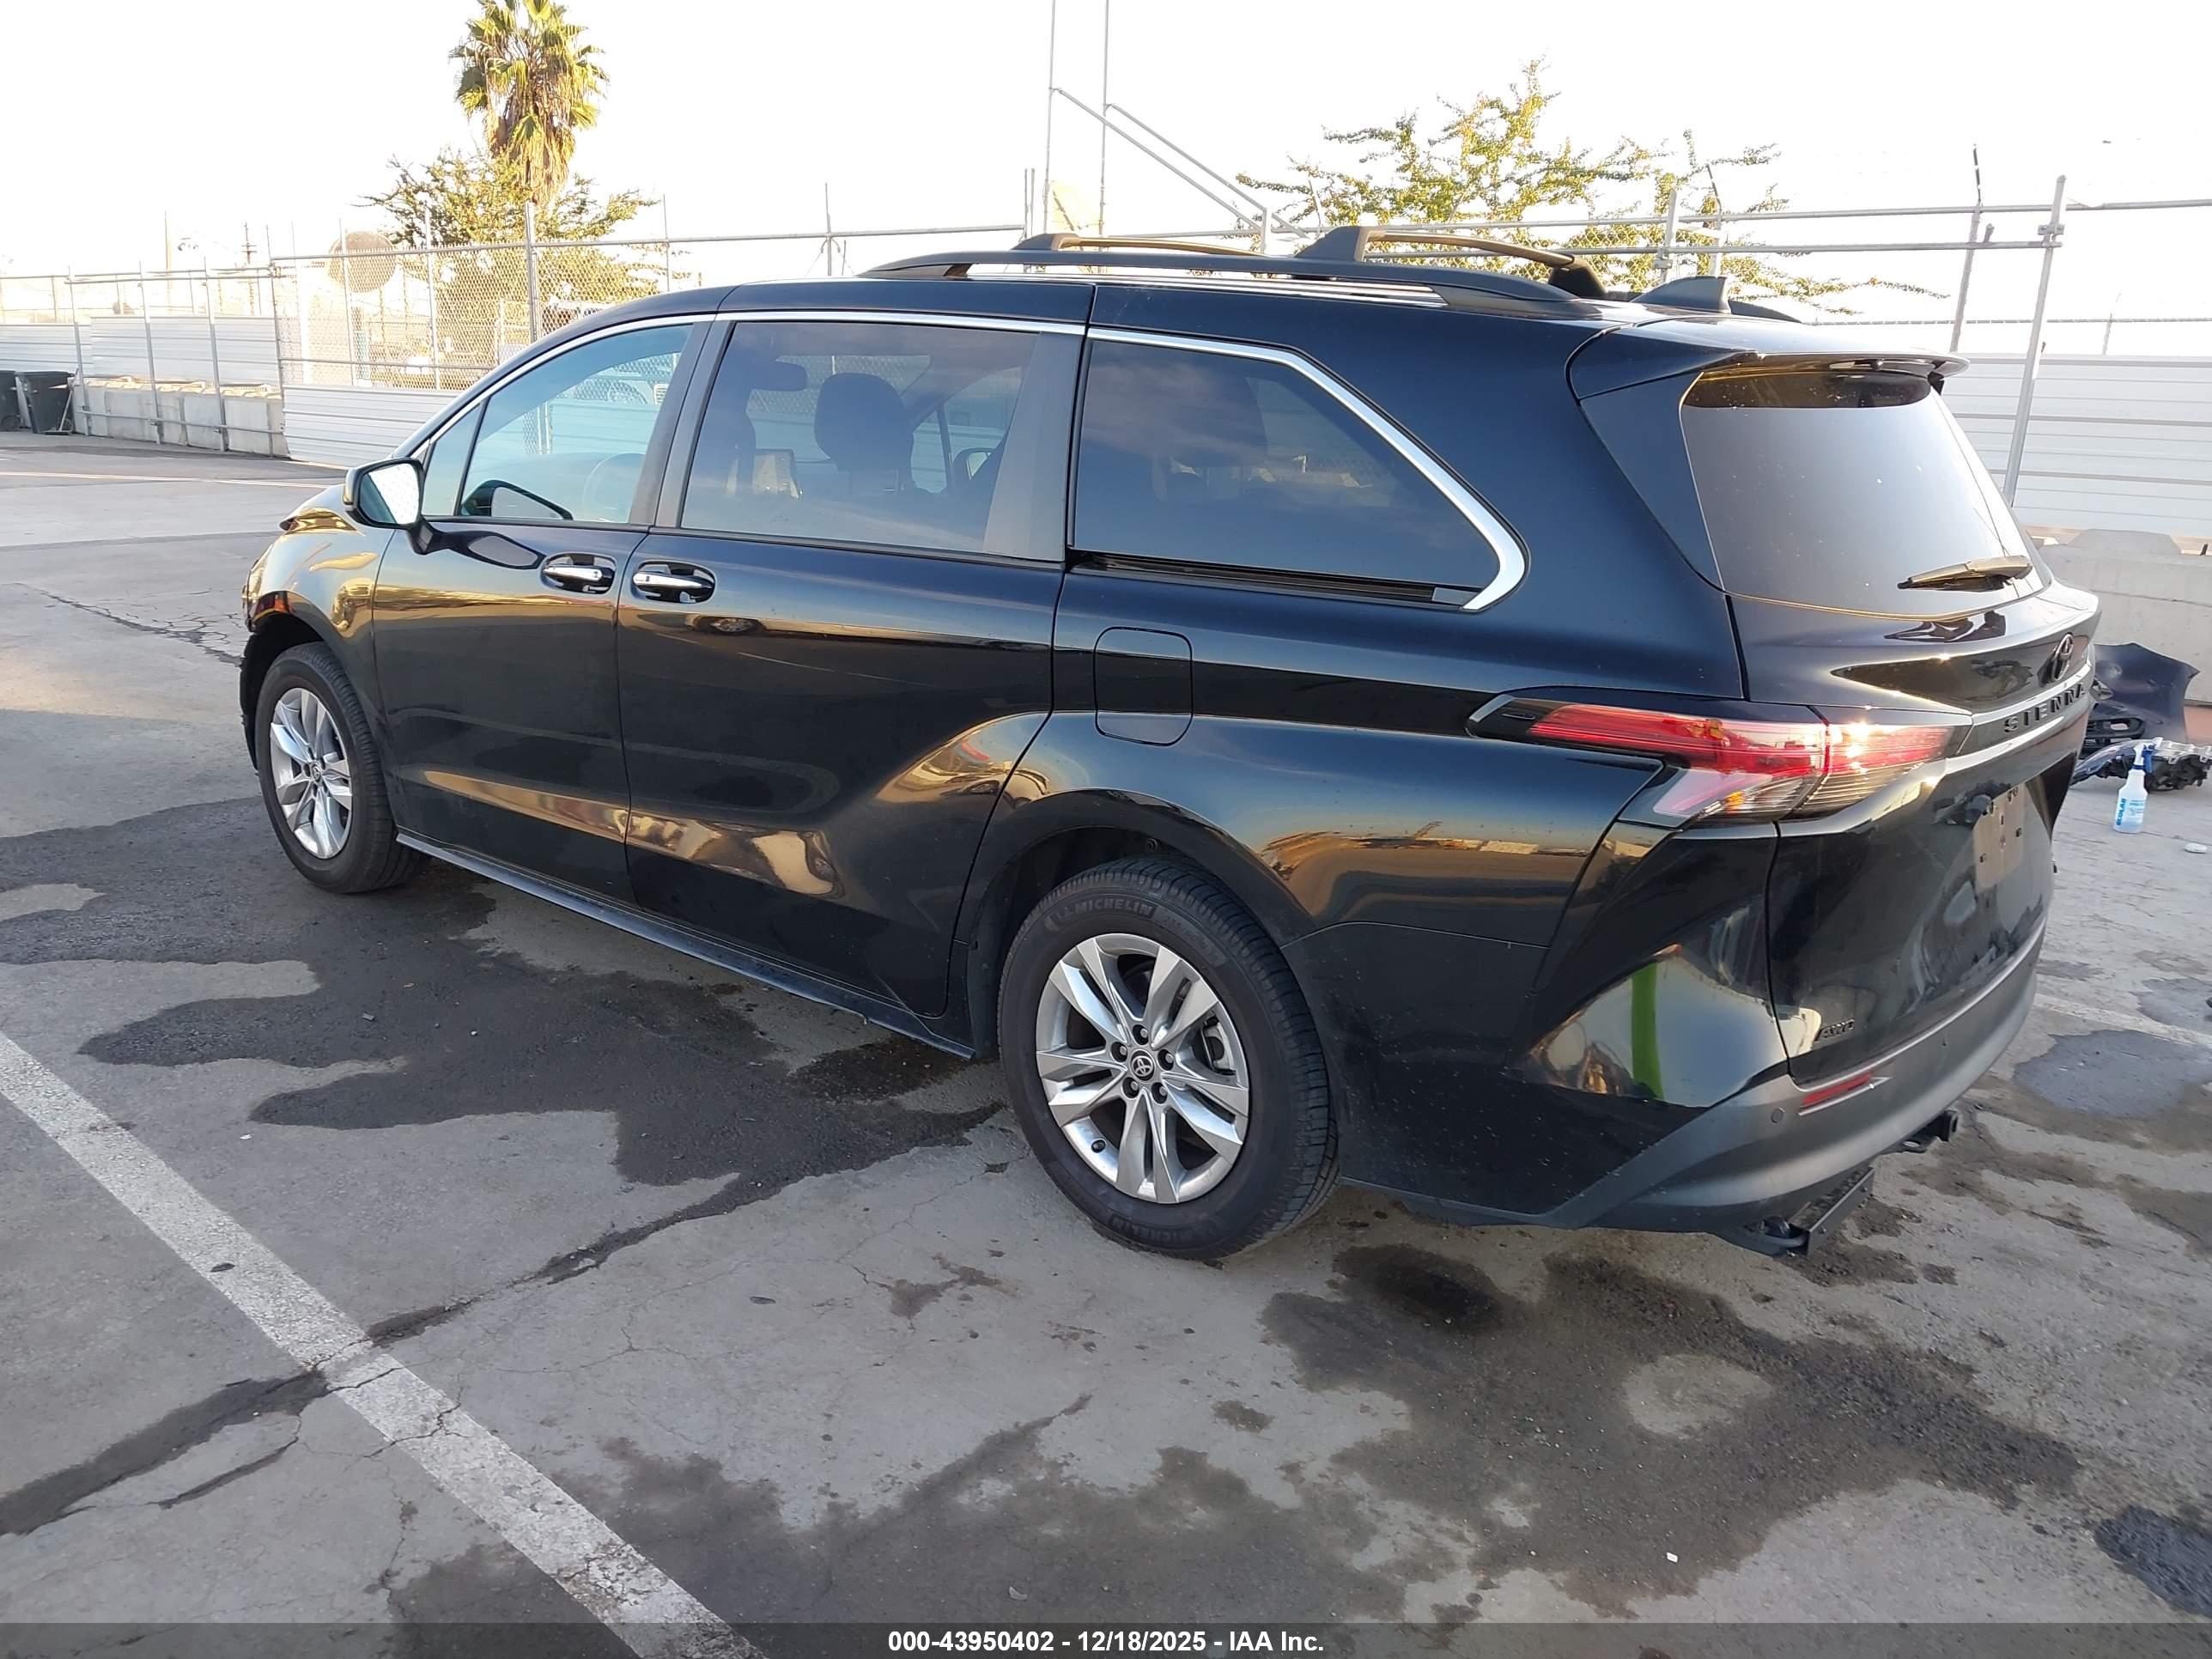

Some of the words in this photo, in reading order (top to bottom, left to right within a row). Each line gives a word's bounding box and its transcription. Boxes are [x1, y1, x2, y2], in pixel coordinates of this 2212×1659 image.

[2004, 684, 2086, 732] SIENNA
[2116, 798, 2128, 827] ECOLAB
[1075, 898, 1152, 917] MICHELIN
